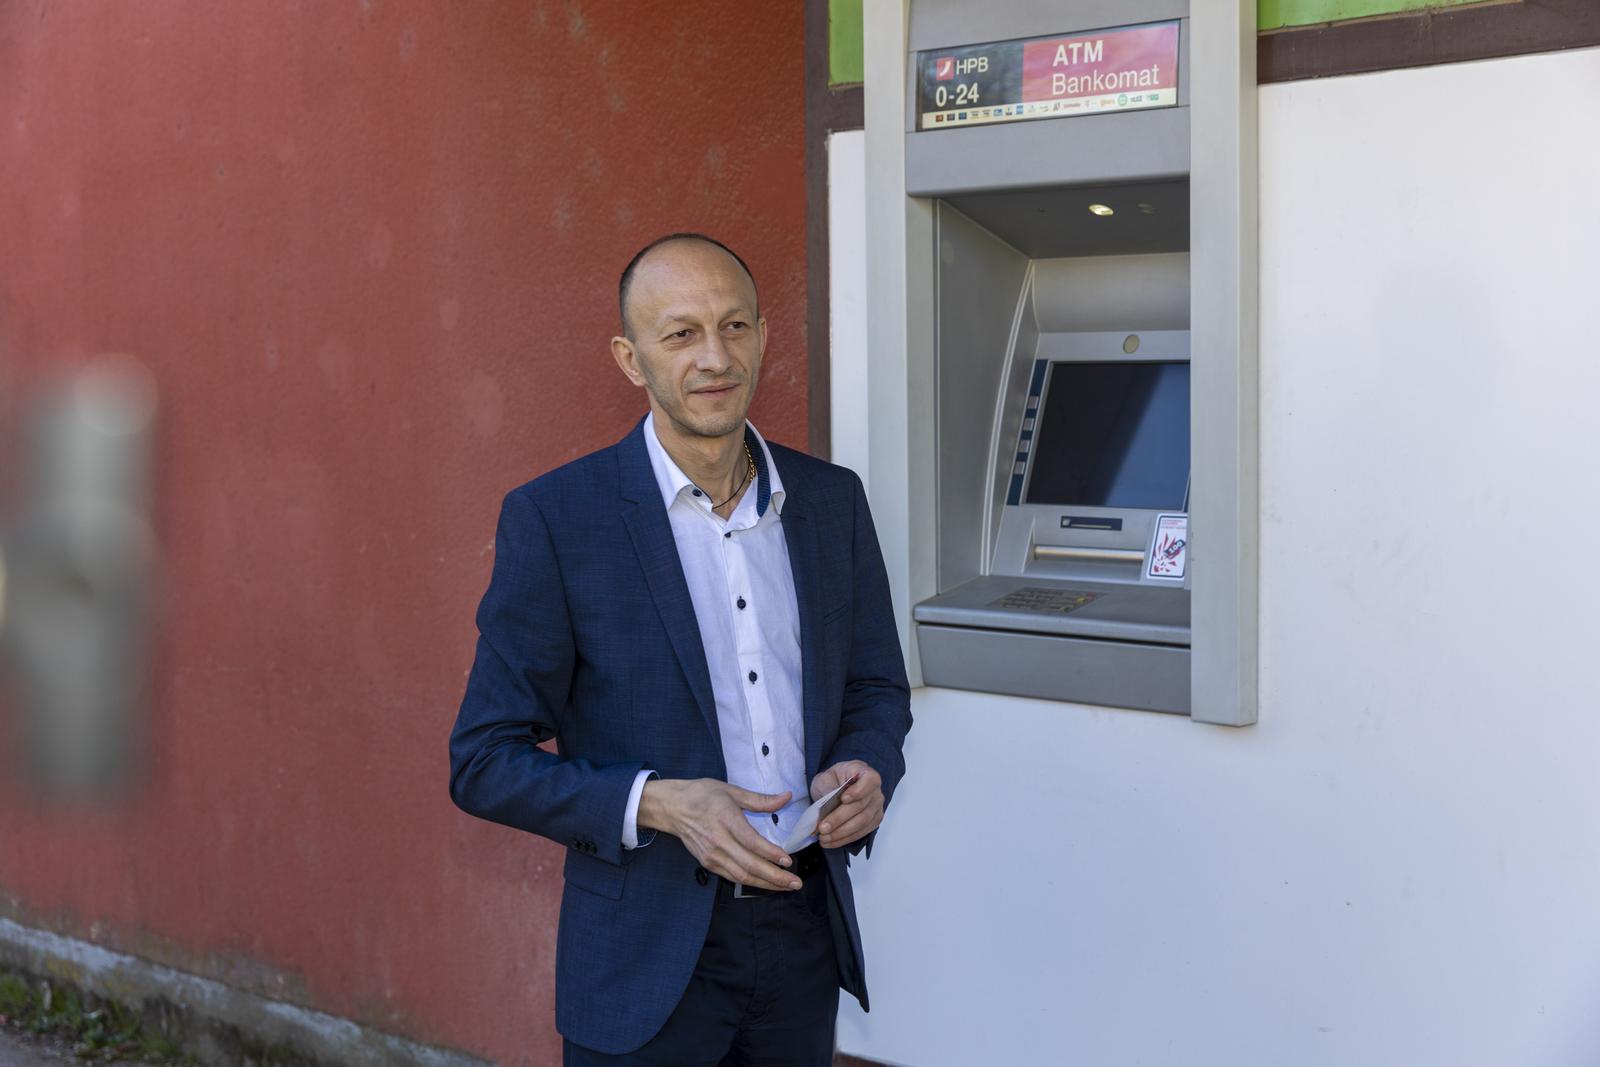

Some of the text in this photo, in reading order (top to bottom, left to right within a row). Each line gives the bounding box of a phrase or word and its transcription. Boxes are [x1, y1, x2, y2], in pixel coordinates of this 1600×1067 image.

[1053, 40, 1103, 67] ATM
[956, 57, 989, 75] HPB
[1052, 63, 1159, 96] Bankomat
[935, 83, 979, 107] 0-24
[1168, 541, 1183, 553] 100
